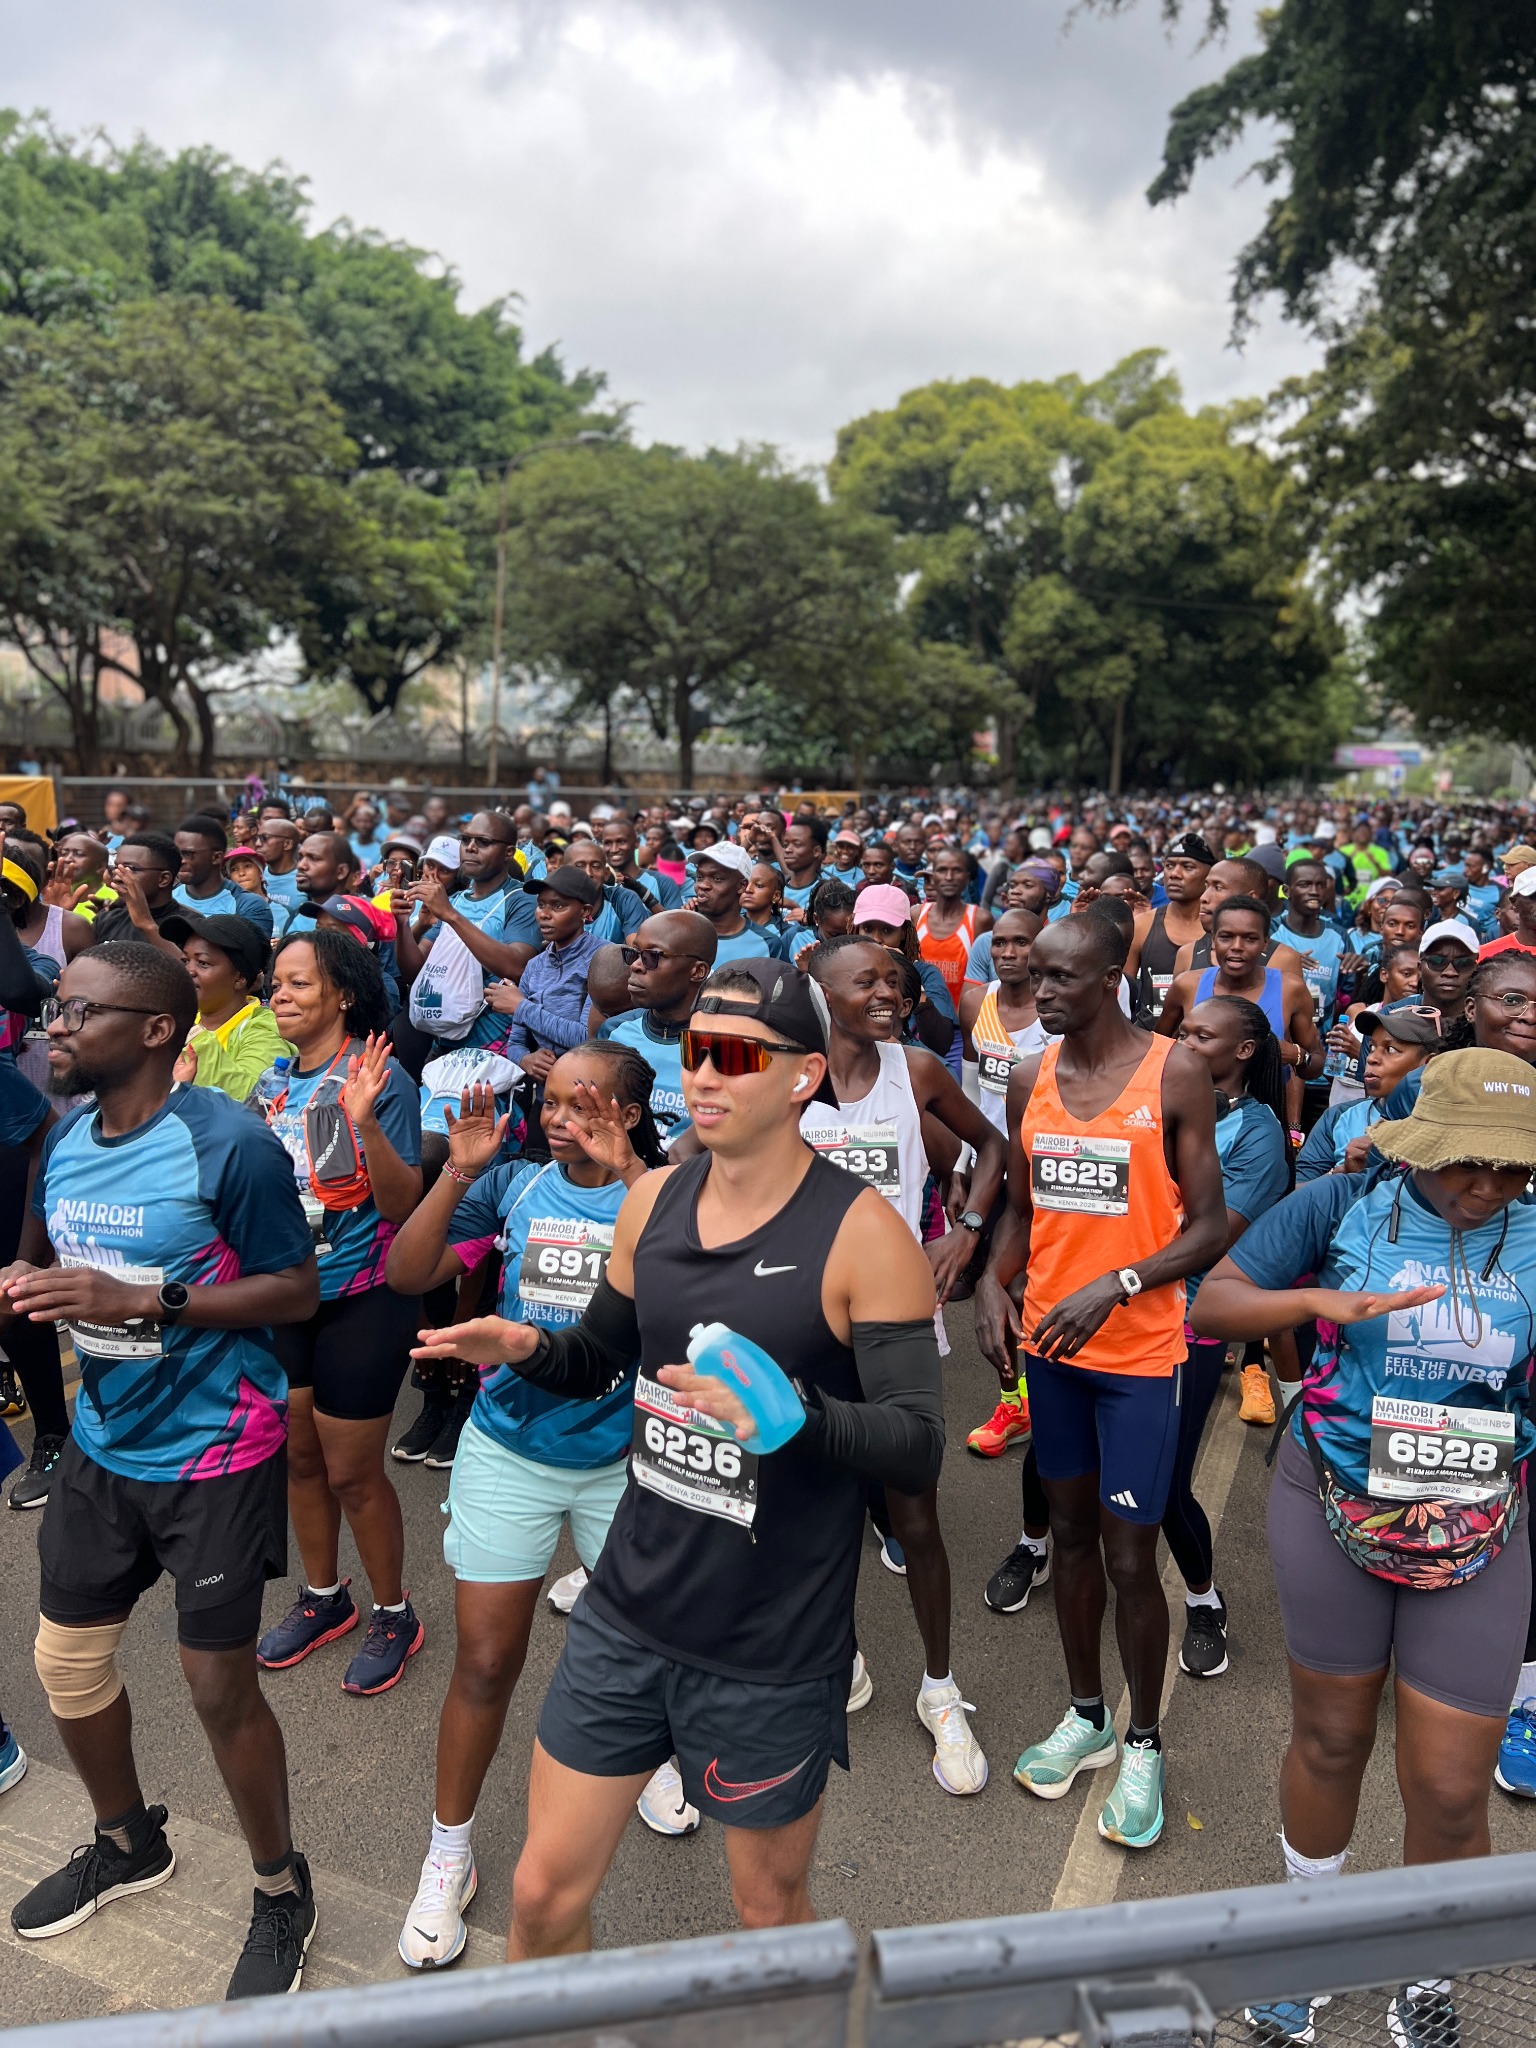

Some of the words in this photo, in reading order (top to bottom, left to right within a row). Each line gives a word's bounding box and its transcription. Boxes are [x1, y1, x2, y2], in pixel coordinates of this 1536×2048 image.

[985, 1057, 1016, 1077] 86
[1483, 1081, 1509, 1093] WHY
[1511, 1083, 1530, 1097] THO
[1122, 1118, 1157, 1128] adidas
[1034, 1135, 1070, 1147] NAIROBI
[819, 1149, 887, 1172] 633
[1040, 1158, 1118, 1188] 8625
[64, 1199, 145, 1227] NAIROBI
[66, 1222, 86, 1232] CITY
[88, 1224, 144, 1238] MARATHON
[532, 1221, 577, 1235] NAIROBI
[538, 1247, 610, 1279] 691
[555, 1294, 577, 1303] KENYA
[1451, 1286, 1518, 1303] MARATHON
[523, 1301, 546, 1311] FEEL
[522, 1309, 552, 1321] PULSE
[554, 1312, 569, 1323] OF
[101, 1343, 120, 1351] 2026
[1385, 1355, 1418, 1368] FEEL
[1420, 1360, 1447, 1371] THE
[1385, 1366, 1425, 1380] PULSE
[1428, 1370, 1446, 1380] OF
[649, 1398, 679, 1415] MARATHON
[1376, 1400, 1434, 1419] NAIROBI
[1375, 1411, 1391, 1420] CITY
[1393, 1413, 1433, 1425] MARATHON
[645, 1417, 741, 1479] 6236
[1388, 1431, 1498, 1472] 6528
[664, 1461, 672, 1470] KM
[672, 1464, 685, 1475] HALF
[685, 1469, 721, 1486] MARATHON
[1406, 1466, 1414, 1474] 21
[1440, 1470, 1475, 1479] MARATHON
[665, 1482, 688, 1498] KENYA
[690, 1492, 712, 1504] 2026
[1417, 1485, 1438, 1493] KENYA
[1440, 1485, 1461, 1494] 2026
